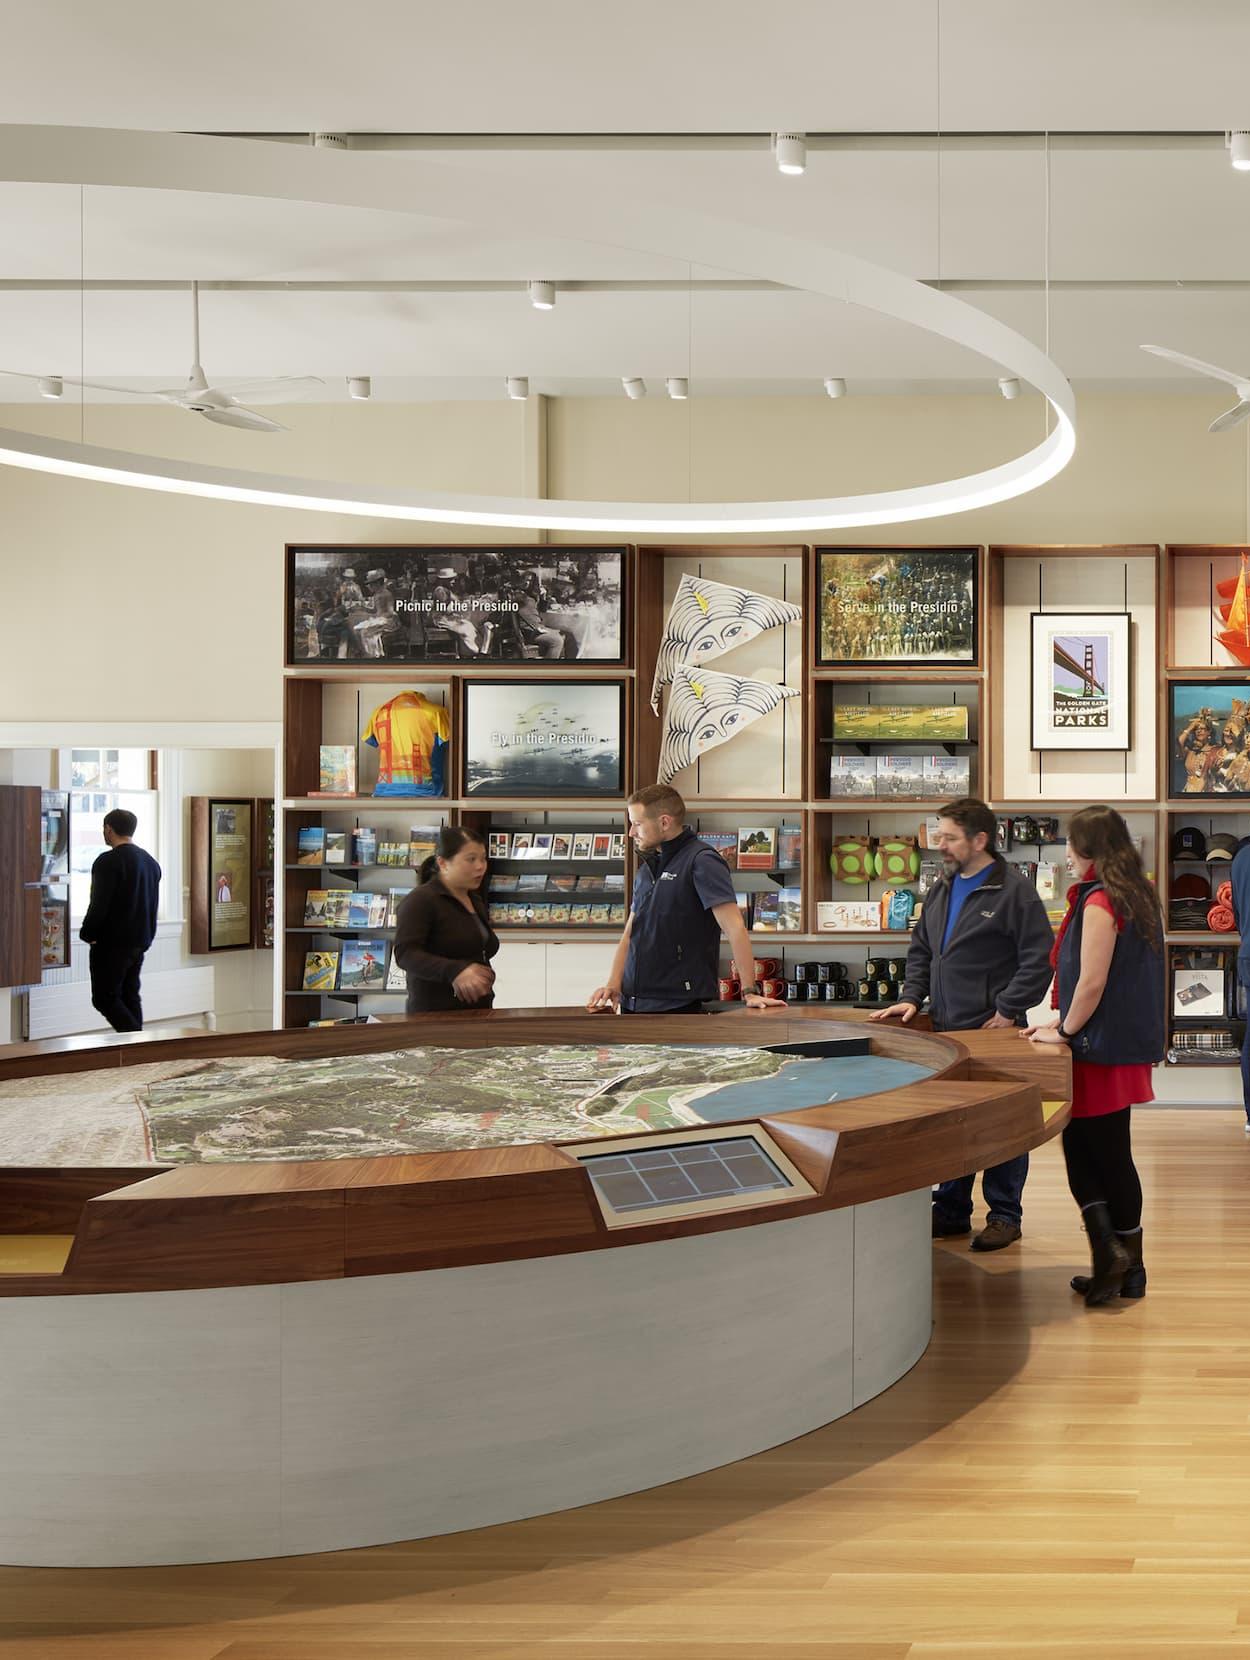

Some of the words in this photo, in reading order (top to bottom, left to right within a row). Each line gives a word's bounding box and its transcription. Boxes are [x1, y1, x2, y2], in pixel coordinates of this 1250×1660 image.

[395, 600, 432, 612] Picnic
[436, 600, 447, 612] in
[450, 600, 467, 612] the
[472, 600, 519, 612] Presidio
[838, 601, 869, 613] Serve
[874, 601, 884, 613] in
[888, 601, 906, 613] the
[910, 601, 957, 613] Presidio
[1055, 715, 1107, 726] PARKS
[512, 733, 522, 744] in
[527, 733, 545, 744] the
[548, 733, 596, 744] Presidio
